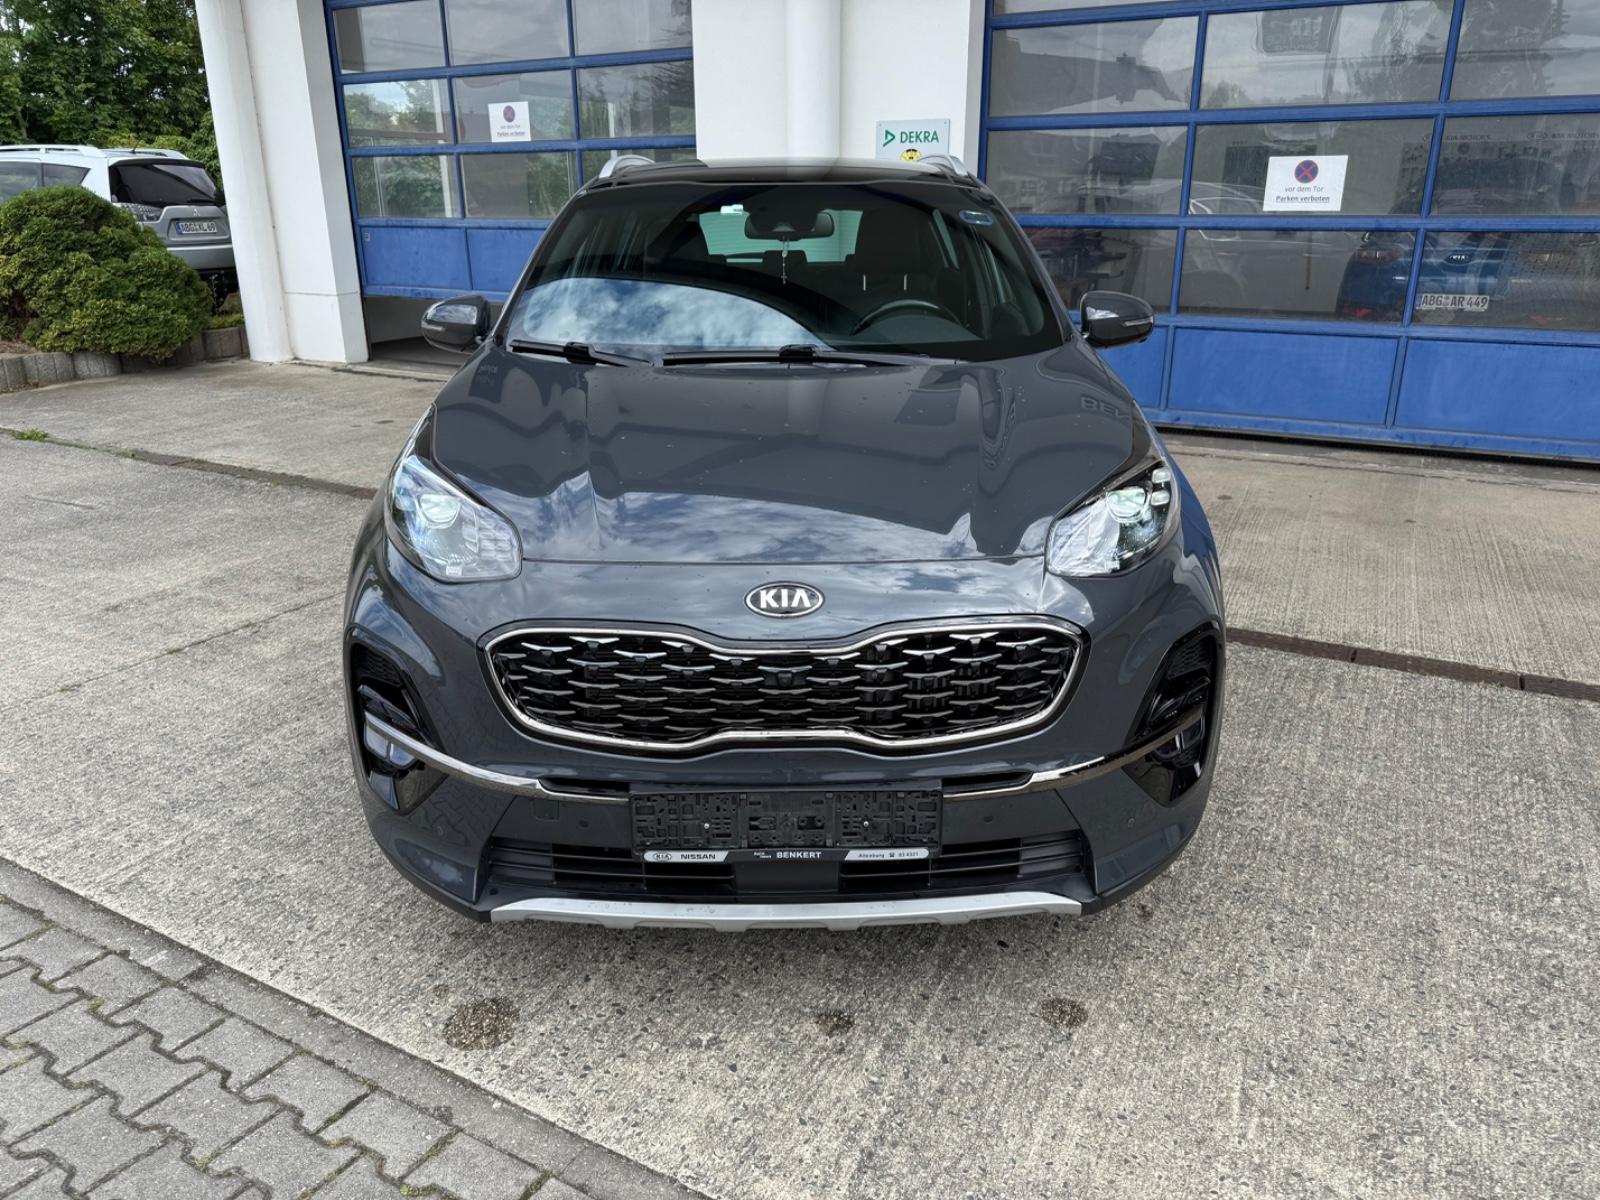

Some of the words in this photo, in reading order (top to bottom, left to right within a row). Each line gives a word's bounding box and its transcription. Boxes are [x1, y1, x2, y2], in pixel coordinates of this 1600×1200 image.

[900, 130, 940, 144] DEKRA
[1313, 185, 1325, 193] Tor
[1276, 195, 1299, 203] Parken
[1300, 195, 1330, 203] verboten
[1421, 295, 1443, 306] ABG
[1450, 295, 1465, 307] AR
[1466, 296, 1488, 308] 449
[760, 588, 812, 609] KIA
[776, 851, 822, 859] BENKERT
